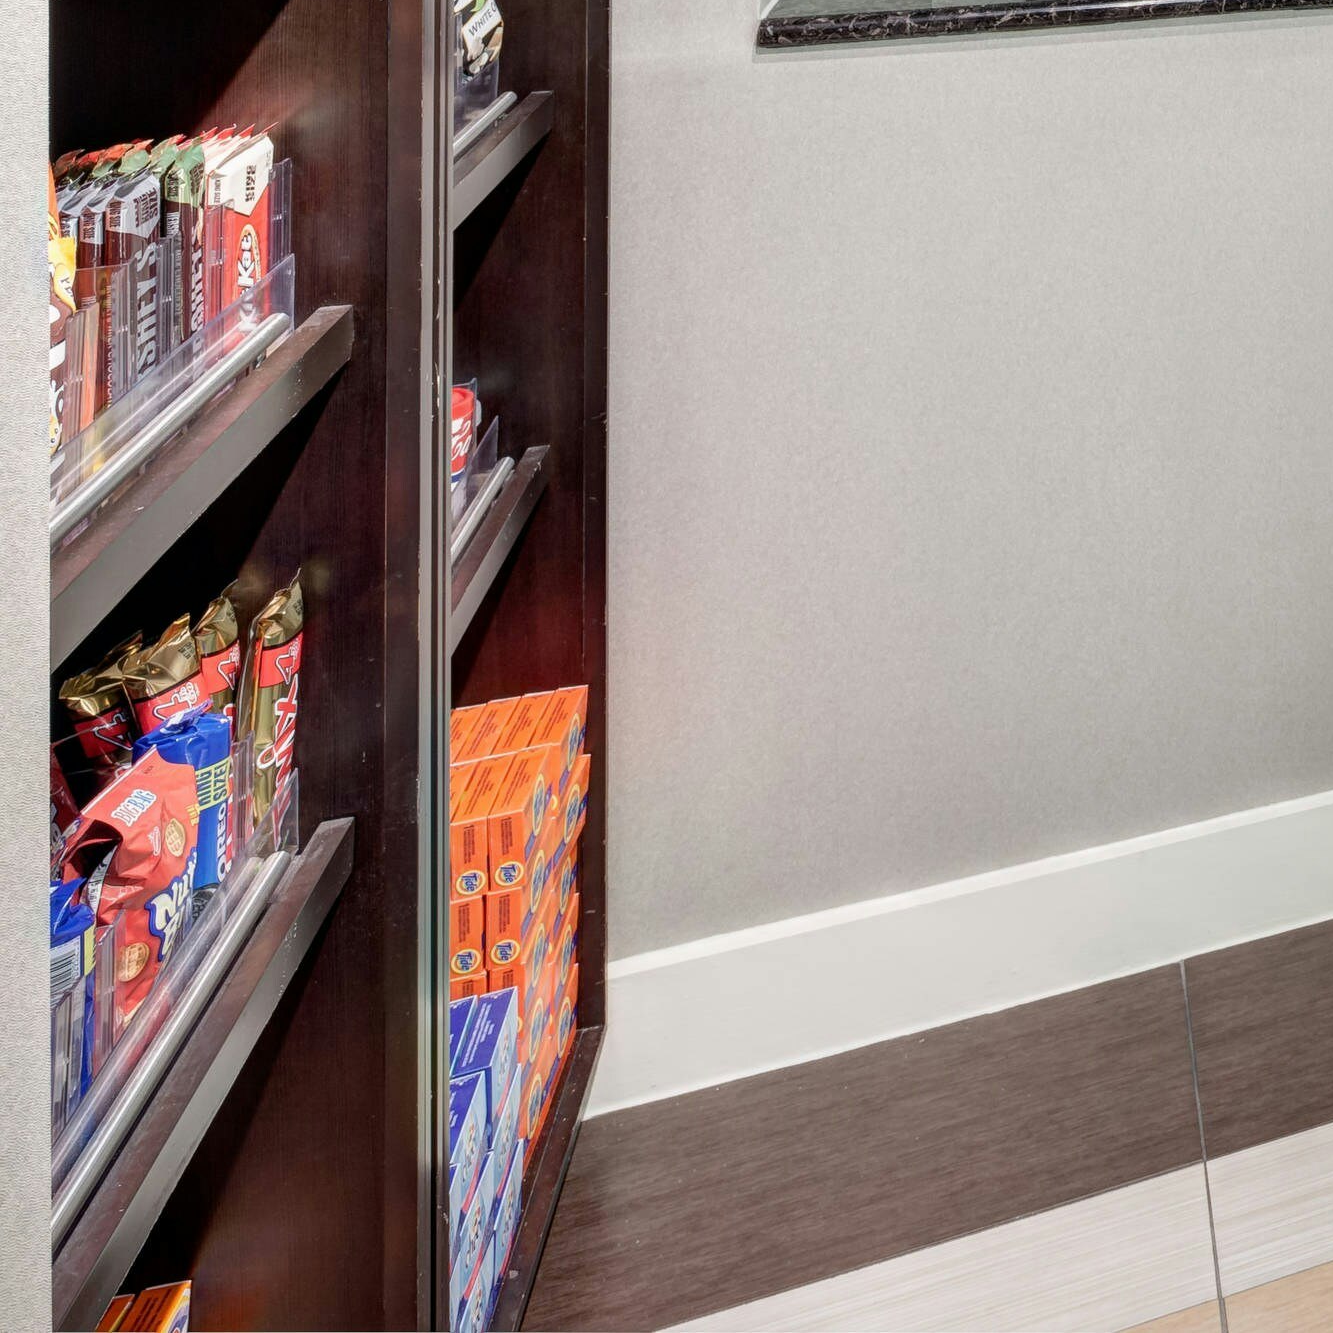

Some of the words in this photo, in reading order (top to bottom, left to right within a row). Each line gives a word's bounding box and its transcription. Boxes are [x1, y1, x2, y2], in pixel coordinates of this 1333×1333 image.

[215, 802, 227, 882] OREO
[461, 871, 481, 894] Tide
[499, 862, 519, 885] Tide
[456, 951, 477, 971] Tide
[496, 941, 516, 963] Tide
